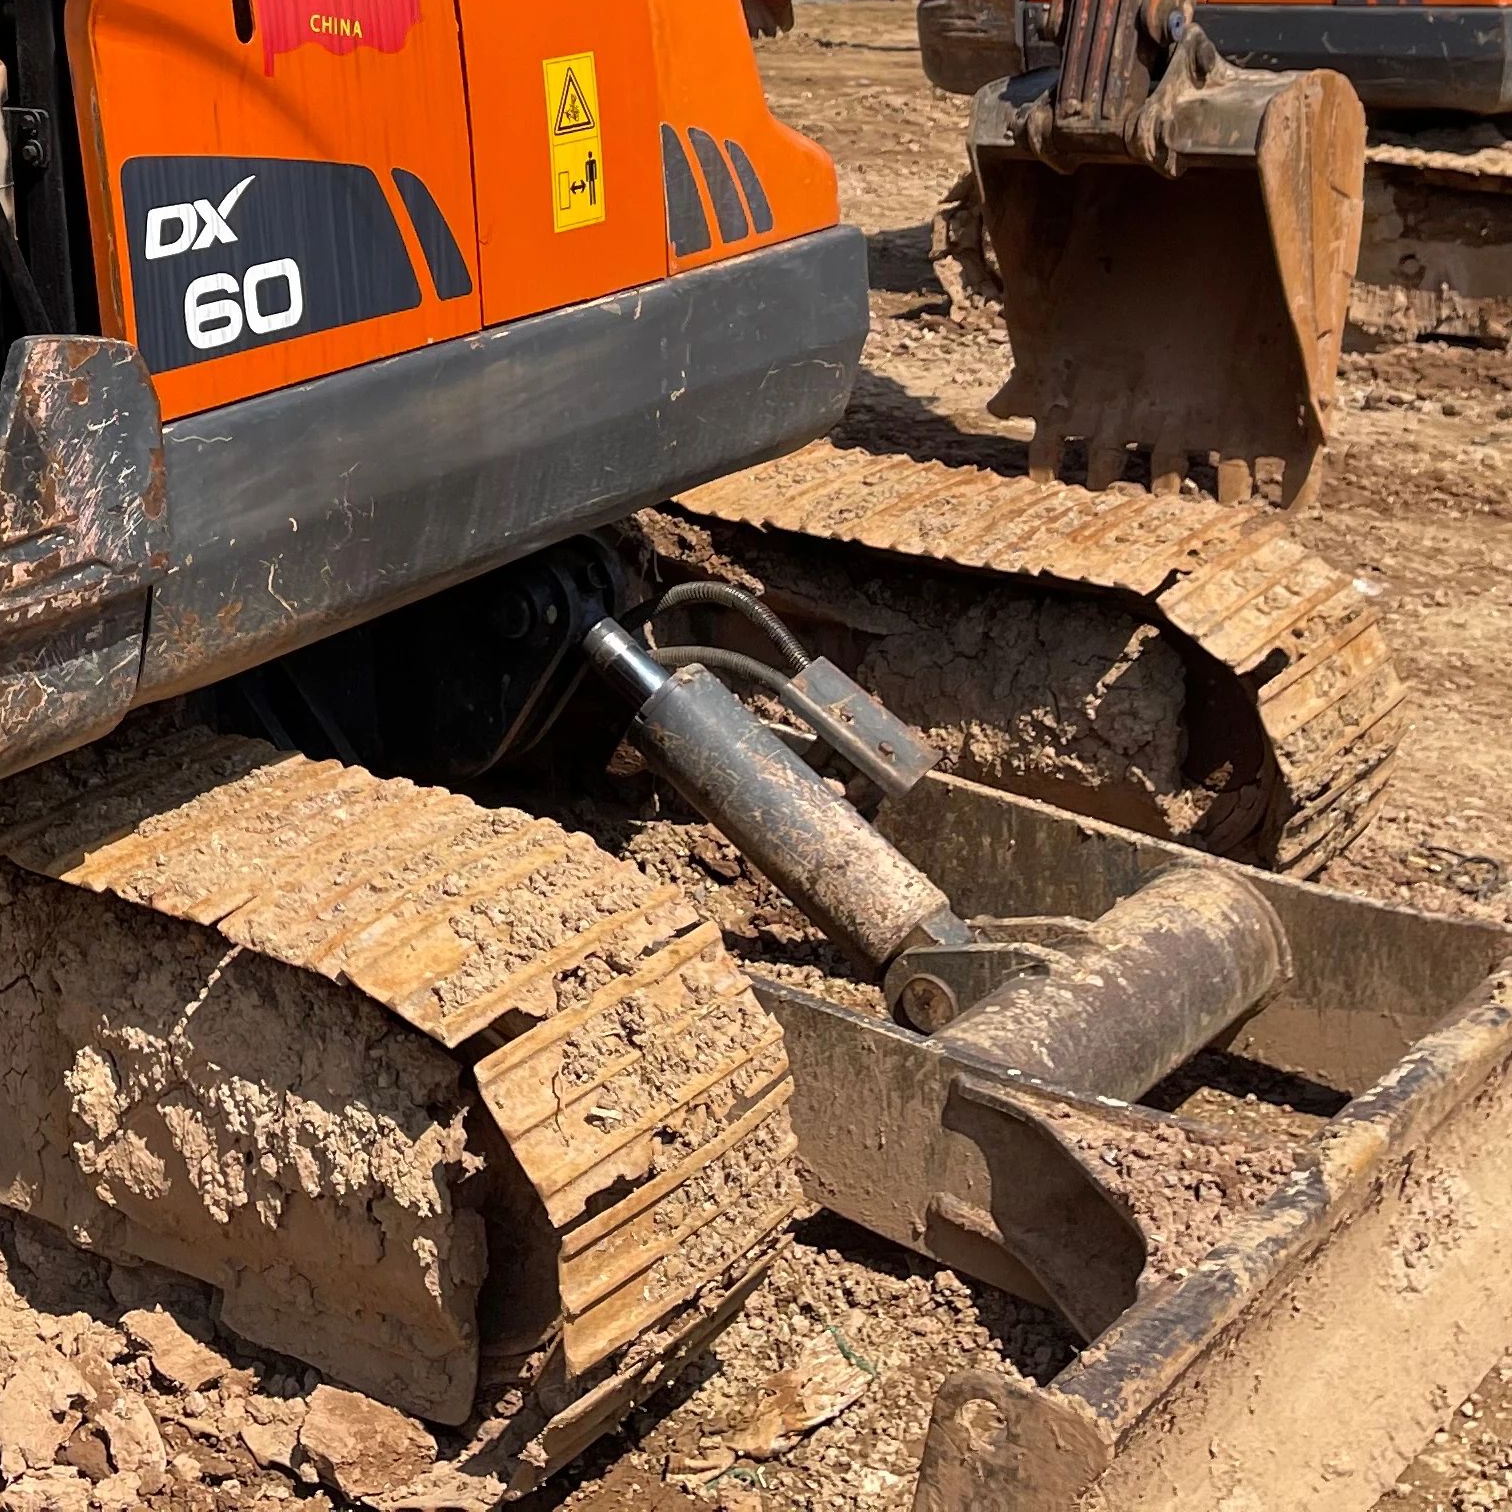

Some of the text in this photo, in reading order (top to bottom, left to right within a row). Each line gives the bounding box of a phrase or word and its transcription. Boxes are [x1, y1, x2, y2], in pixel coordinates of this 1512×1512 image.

[310, 14, 363, 38] CHINA
[145, 174, 256, 260] DX
[184, 257, 303, 349] 60
